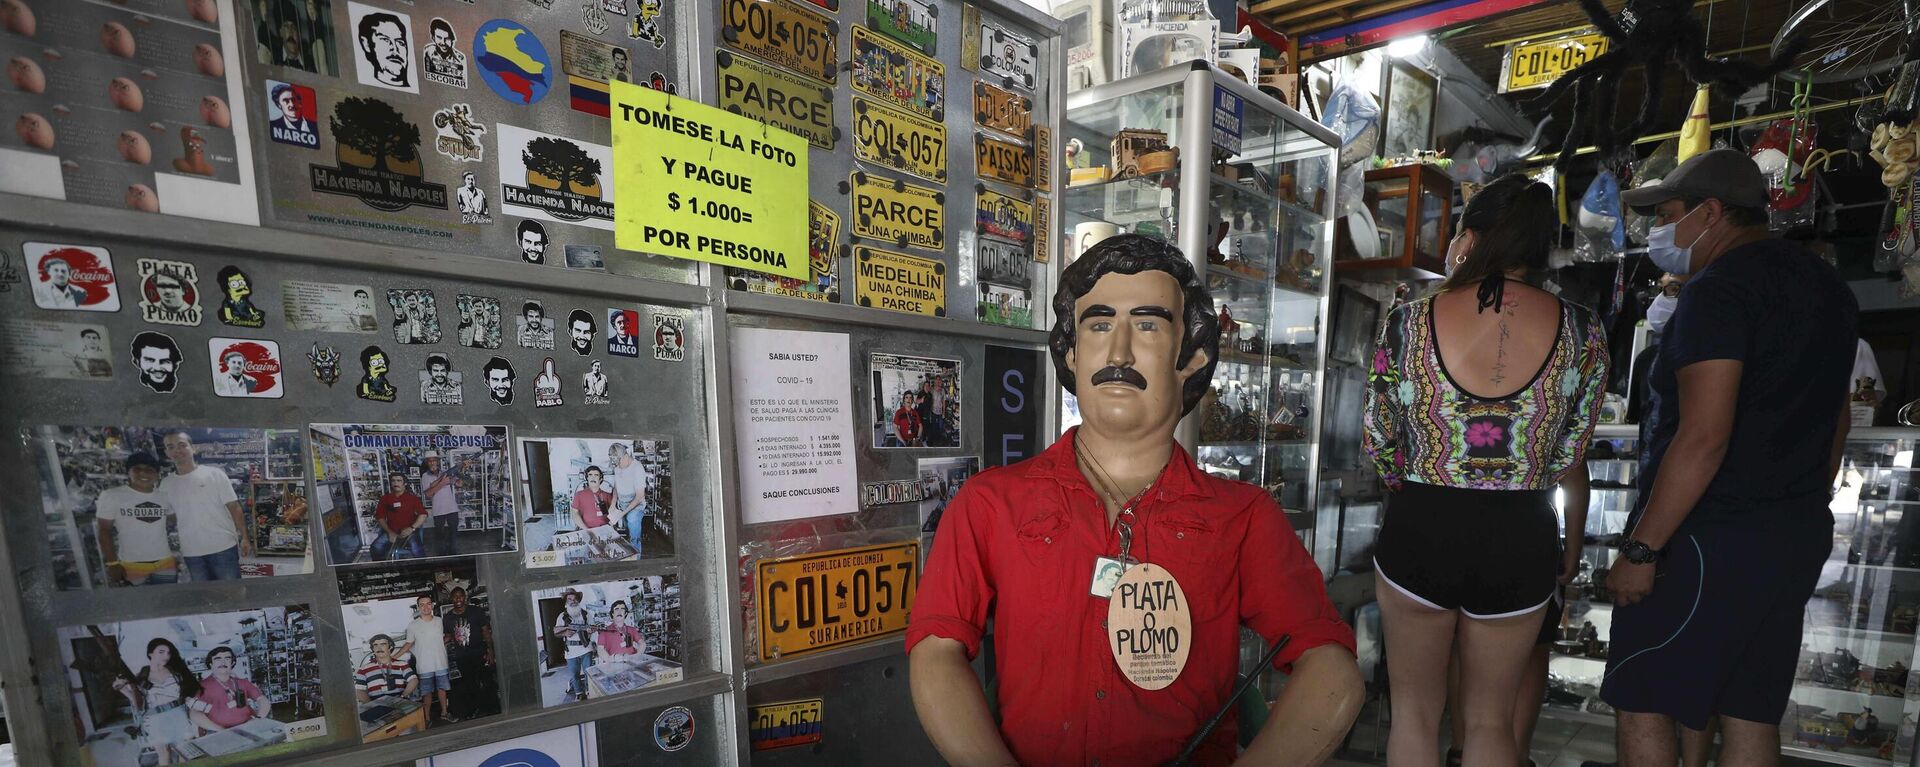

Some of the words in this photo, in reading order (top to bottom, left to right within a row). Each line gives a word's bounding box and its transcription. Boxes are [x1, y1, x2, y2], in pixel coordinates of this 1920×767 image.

[789, 5, 821, 24] COLOMBIA
[730, 0, 780, 47] COL
[793, 22, 831, 70] 057
[1154, 23, 1189, 32] HACIENDA
[744, 43, 783, 64] AMERICA
[785, 57, 803, 70] DEL
[804, 66, 820, 78] SUR
[905, 53, 931, 67] COLOMBIA
[1515, 50, 1552, 78] COL
[1561, 42, 1603, 71] 057
[425, 73, 467, 88] ESCOBAR
[774, 72, 785, 80] DE
[784, 76, 816, 91] COLOMBIA
[725, 74, 828, 127] PARCE
[867, 87, 898, 103] AMERICA
[901, 99, 914, 110] DEL
[916, 105, 930, 116] SUR
[618, 102, 713, 142] TOMESE
[719, 130, 745, 152] LA
[750, 139, 796, 167] FOTO
[907, 118, 933, 131] COLOMBIA
[273, 127, 317, 146] NARCO
[859, 115, 900, 155] COL
[911, 131, 942, 168] 057
[979, 143, 1030, 176] PAISAS
[661, 156, 677, 175] Y
[684, 161, 753, 194] PAGUE
[905, 164, 917, 173] DEL
[920, 167, 932, 177] SUR
[314, 169, 383, 194] HACIENDA
[389, 181, 443, 204] NAPOLES
[904, 188, 930, 199] COLOMBIA
[505, 187, 565, 209] HACIENDA
[571, 199, 615, 217] NAPOLE
[667, 191, 680, 212] $
[688, 197, 753, 224] 1.000=
[858, 194, 938, 230] PARCE
[869, 224, 890, 238] UNA
[893, 229, 931, 246] CHIMBA
[643, 226, 690, 250] POR
[697, 235, 787, 269] PERSONA
[142, 261, 194, 280] PLATA
[907, 260, 932, 269] COLOMBIA
[982, 245, 1002, 275] COL
[1009, 252, 1029, 281] 057
[70, 269, 110, 281] Cocaine
[860, 261, 941, 290] MEDELLÍN
[748, 284, 788, 297] AMERICA
[789, 289, 806, 299] DEL
[807, 291, 824, 302] SUR
[869, 281, 893, 295] UNA
[896, 285, 937, 302] CHIMBA
[882, 296, 922, 313] PARCE
[655, 316, 682, 329] PLATA
[610, 343, 637, 355] NARCO
[769, 353, 790, 361] SABIA
[792, 354, 819, 362] USTED?
[244, 360, 278, 372] Cocaine
[806, 377, 813, 385] 19
[537, 399, 563, 407] PABLO
[344, 434, 431, 449] COMANDANTE
[435, 434, 494, 449] CASPUSIA
[763, 491, 787, 499] SAQUE
[789, 486, 840, 497] CONCLUSIONES
[867, 482, 923, 505] COLOMBIA
[803, 559, 842, 574] REPUBLICA
[842, 559, 851, 568] DE
[852, 553, 885, 567] COLOMBIA
[768, 574, 840, 633] COL
[853, 562, 913, 618] 057
[1117, 580, 1178, 611] PLATA
[809, 617, 884, 645] SURAMERICA
[1143, 611, 1156, 632] O
[1116, 626, 1179, 655] PLOMO
[289, 727, 296, 735] $
[790, 709, 819, 737] 057
